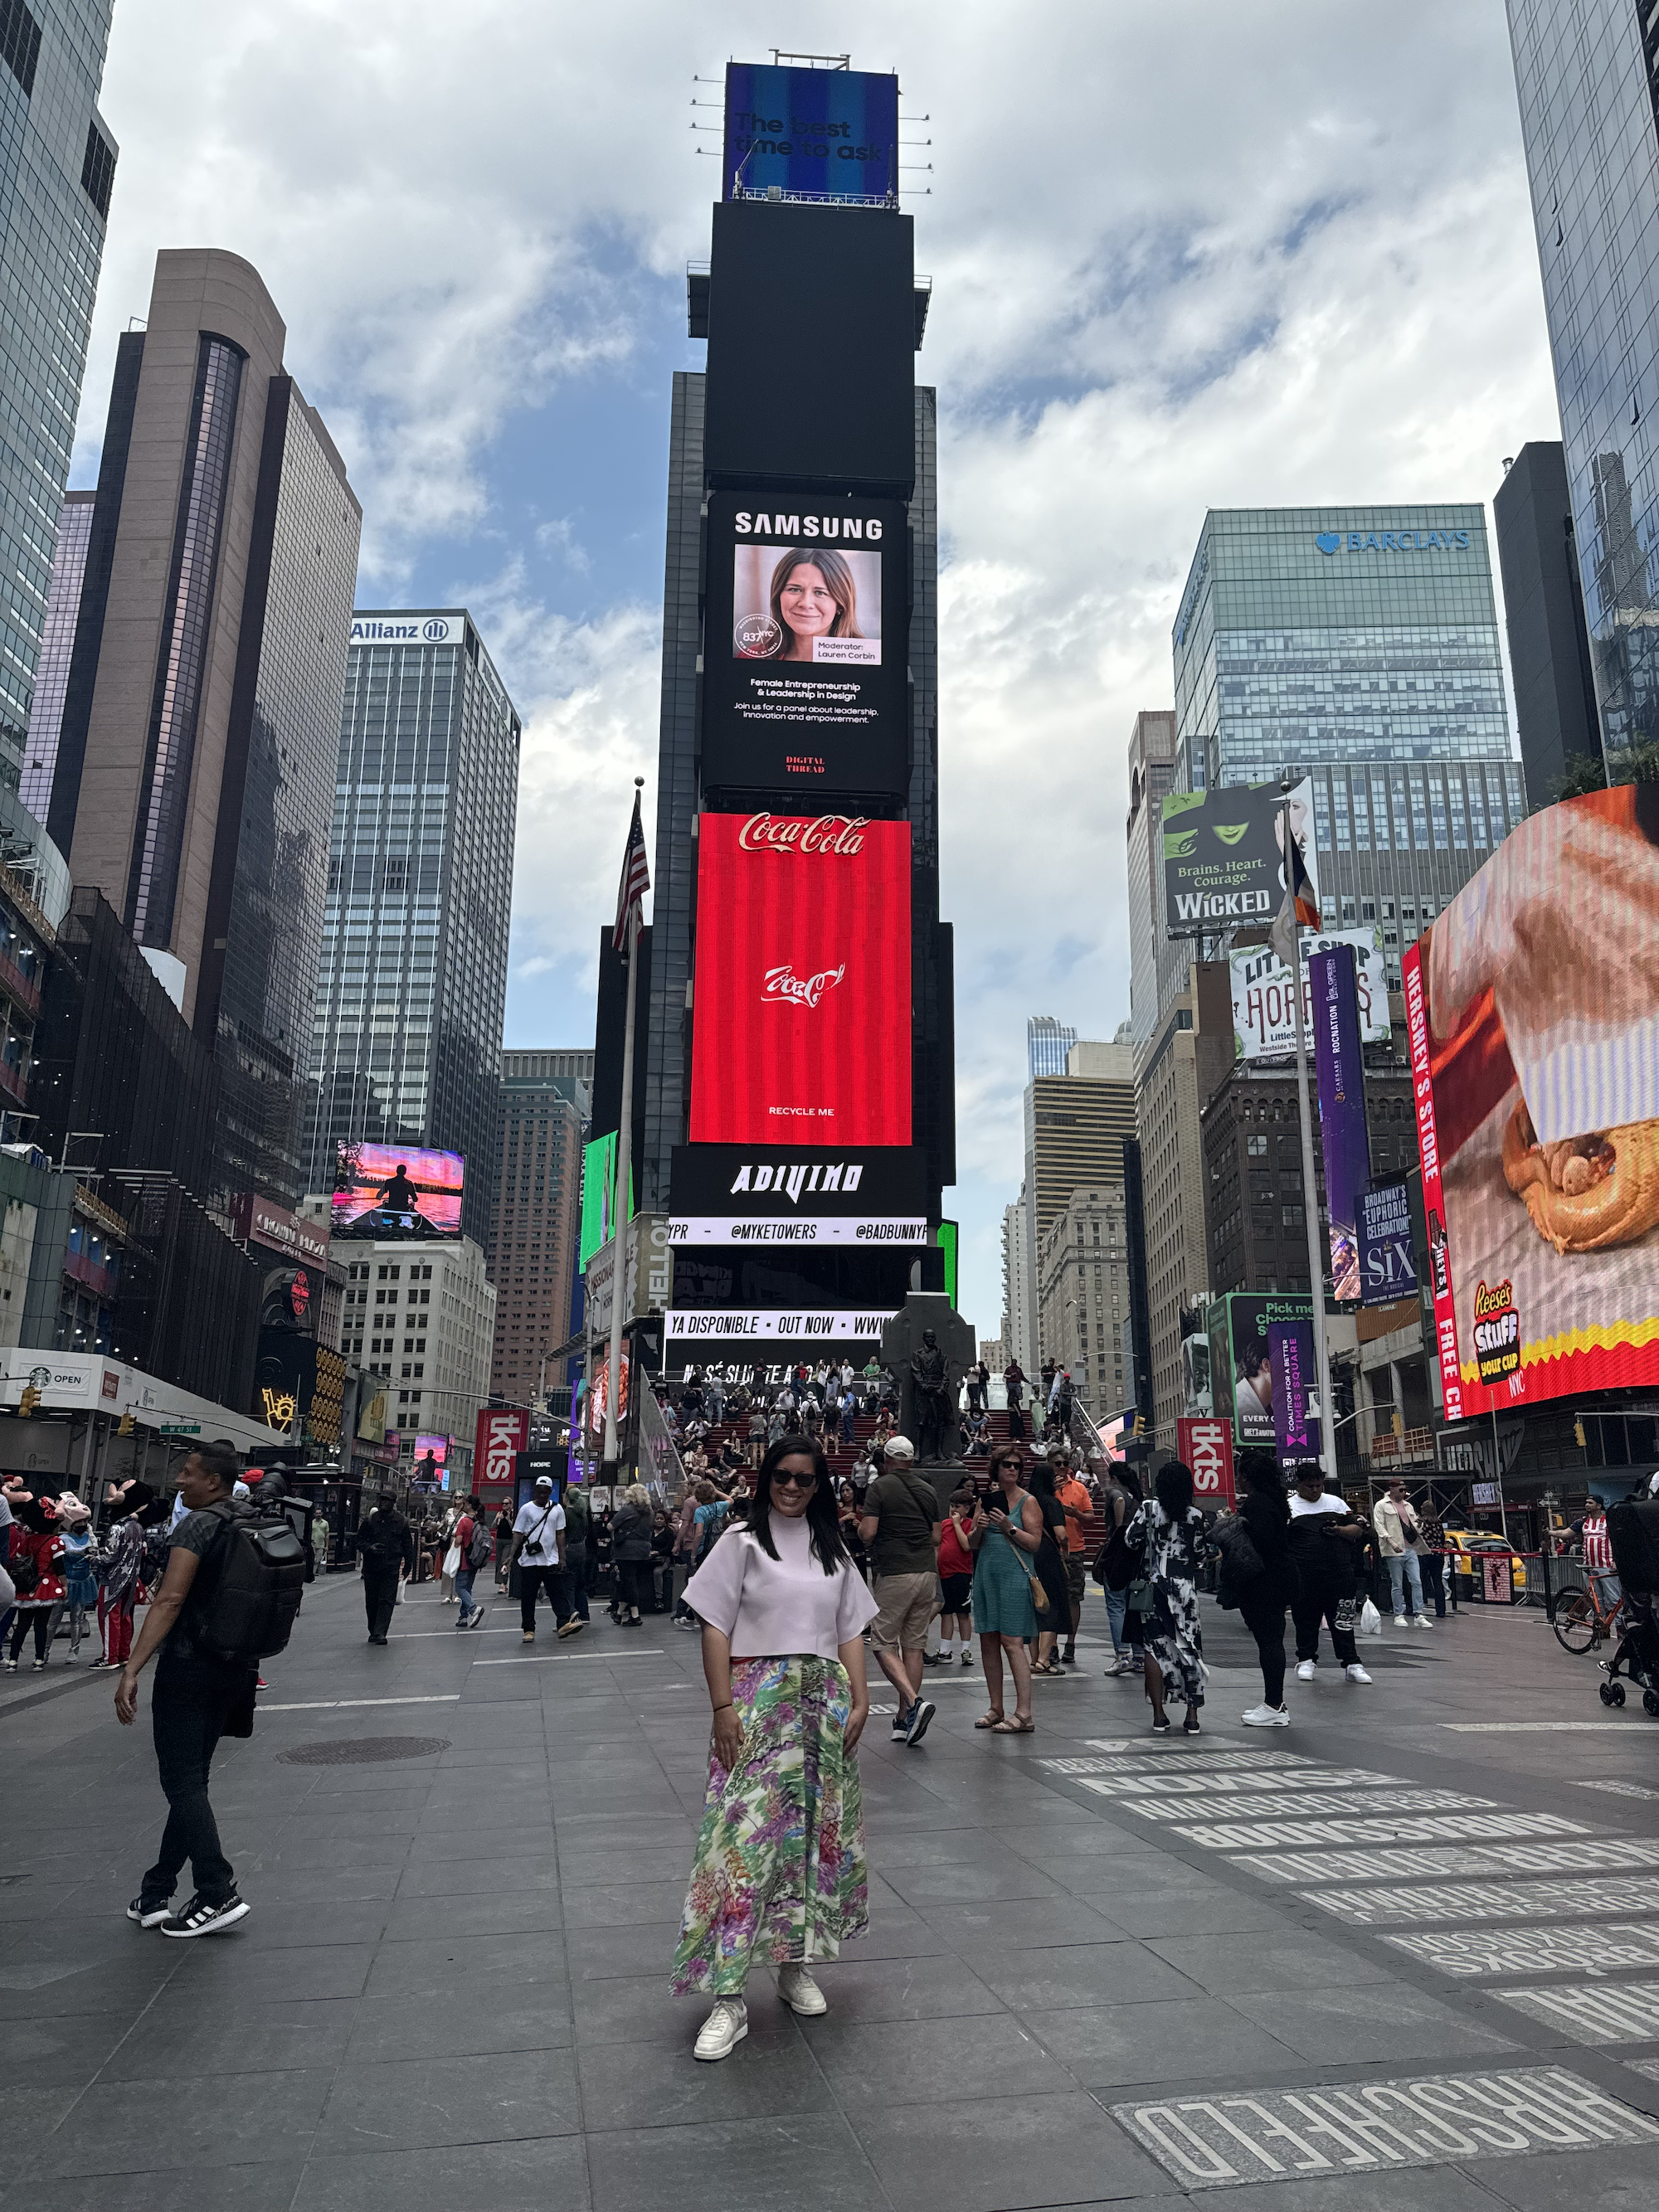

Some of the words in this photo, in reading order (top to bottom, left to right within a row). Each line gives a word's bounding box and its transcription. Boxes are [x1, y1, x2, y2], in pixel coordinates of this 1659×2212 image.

[734, 112, 784, 133] The
[791, 116, 851, 139] best
[734, 134, 793, 155] time
[801, 139, 830, 158] to
[837, 143, 883, 161] ask
[734, 512, 883, 540] SAMSUNG
[1347, 530, 1470, 551] BARCLAYS
[350, 623, 419, 639] Allianz
[742, 632, 761, 642] 837
[818, 642, 864, 650] Moderator:
[848, 652, 876, 660] Corbin
[750, 678, 783, 688] Female
[785, 680, 861, 692] Entrepreneurship
[766, 688, 816, 701] Leadership
[817, 691, 825, 699] in
[826, 692, 856, 702] Design
[743, 711, 786, 720] innovation
[787, 712, 805, 721] and
[805, 713, 869, 724] empowerment.
[783, 705, 807, 714] panel
[808, 706, 833, 714] about
[834, 707, 879, 717] leadership,
[786, 756, 825, 765] DIGITAL
[786, 765, 825, 774] THREAD
[738, 811, 872, 855] Coca-Cola
[1178, 864, 1224, 878] Brains.
[1225, 858, 1267, 872] Heart.
[1194, 873, 1251, 887] Courage.
[1407, 965, 1433, 1098] HERSHEY'S
[1259, 1044, 1287, 1053] Westside
[769, 1106, 815, 1116] RECYCLE
[817, 1108, 834, 1116] ME
[1418, 1101, 1439, 1184] STORE
[730, 1161, 864, 1204] ADIVINO
[1365, 1184, 1406, 1208] BROADWAY'S
[731, 1224, 817, 1239] @MYKETOWERS
[1266, 1302, 1293, 1314] Pick
[1475, 1284, 1511, 1318] Reese's
[672, 1316, 684, 1334] YA
[688, 1316, 759, 1334] DISPONIBLE
[778, 1316, 802, 1334] OUT
[805, 1317, 834, 1334] NOW
[1282, 1339, 1290, 1367] BETTER
[1439, 1318, 1458, 1378] FREE
[1289, 1338, 1301, 1388] SQUARE
[54, 1374, 81, 1384] OPEN
[1508, 1369, 1525, 1398] NYC
[1286, 1392, 1295, 1432] COALITION
[1294, 1393, 1304, 1431] TIMES
[486, 1414, 520, 1480] tkts
[1191, 1423, 1224, 1490] tkts
[1039, 1756, 1140, 1768] WILSON
[1060, 1762, 1146, 1774] AUGUST
[1139, 1752, 1317, 1771] BROADWAY
[1076, 1771, 1353, 1795] SIMON
[1119, 1793, 1361, 1821] GERSHWIN
[1357, 1796, 1498, 1812] CIRCLE
[1170, 1813, 1593, 1848] AMBASSADOR
[1300, 1884, 1535, 1912] FRIEDMAN
[1353, 1911, 1374, 1922] J
[1384, 1903, 1558, 1921] SAMUEL
[1386, 1928, 1614, 1954] ATKINSON
[1428, 1945, 1659, 1974] BROOKS
[1134, 2071, 1659, 2179] HIRSCHFELD
